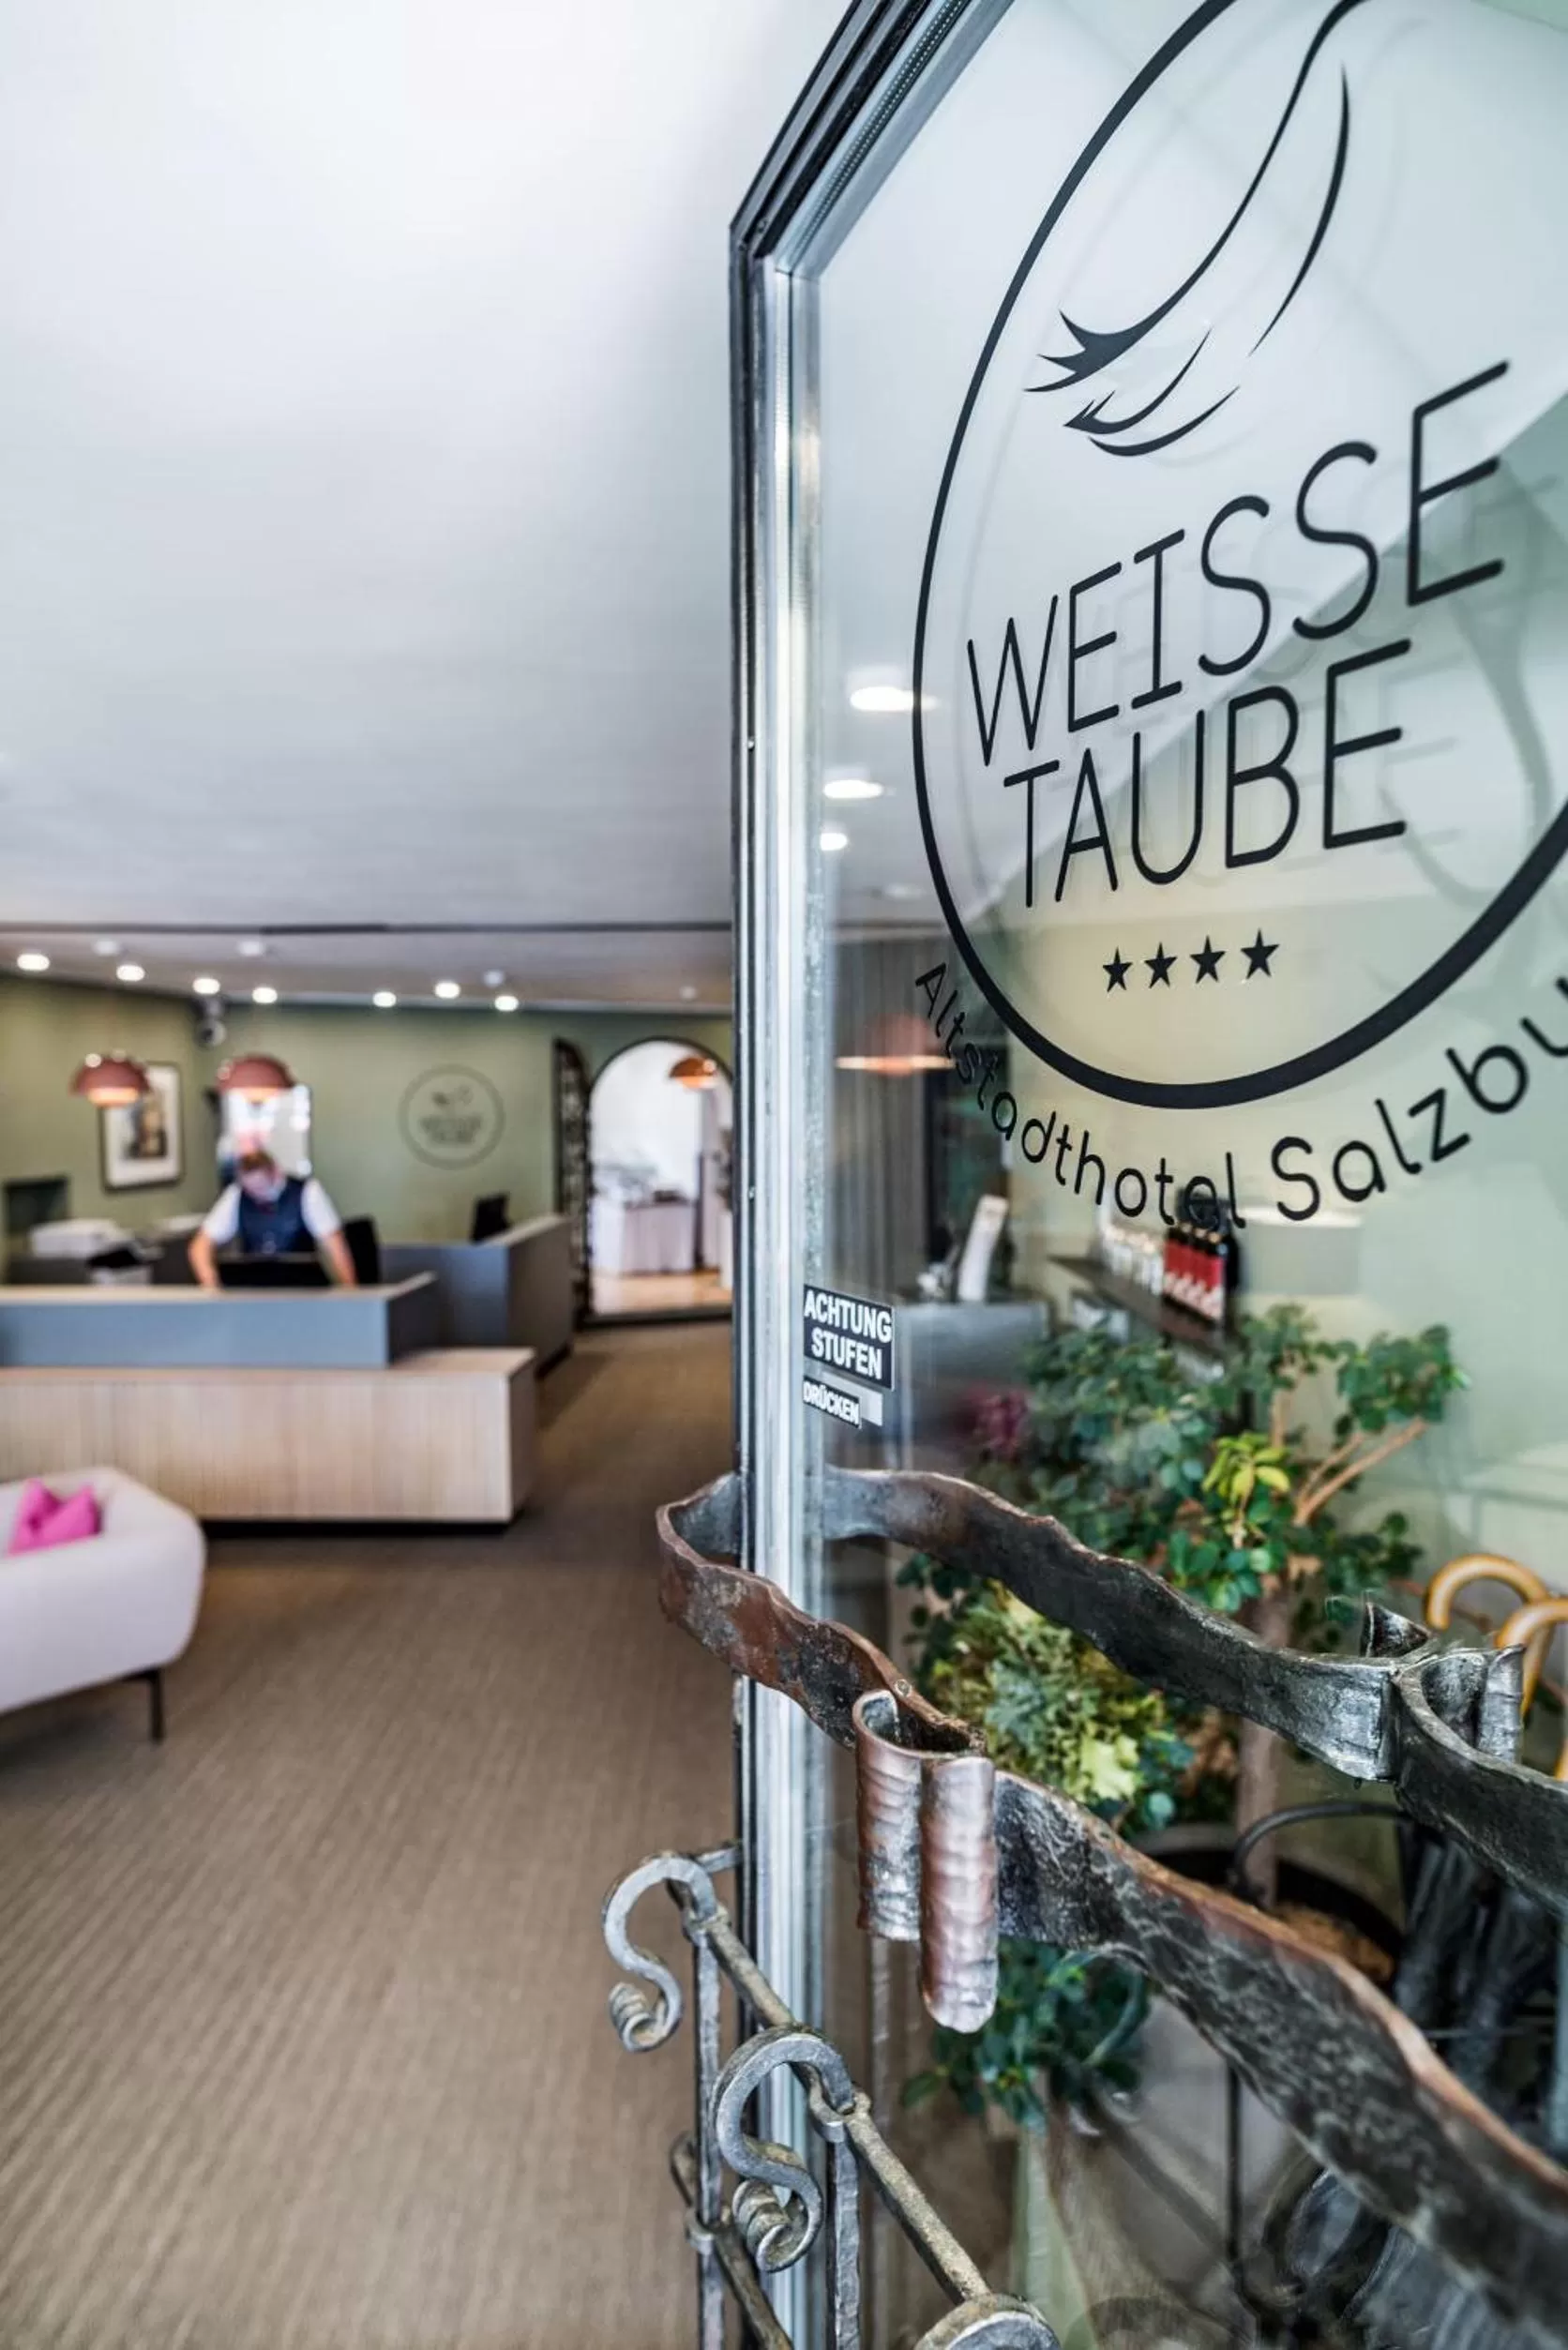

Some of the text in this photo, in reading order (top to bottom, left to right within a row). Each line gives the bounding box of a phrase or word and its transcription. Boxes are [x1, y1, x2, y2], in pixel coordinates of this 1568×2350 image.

[967, 360, 1510, 767] WEISSE
[1003, 638, 1411, 909] TAUBE
[914, 962, 1246, 1229] Altstadthotel
[804, 1288, 893, 1344] ACHTUNG
[811, 1326, 883, 1380] STUFEN
[804, 1380, 860, 1425] DRÜCKEN
